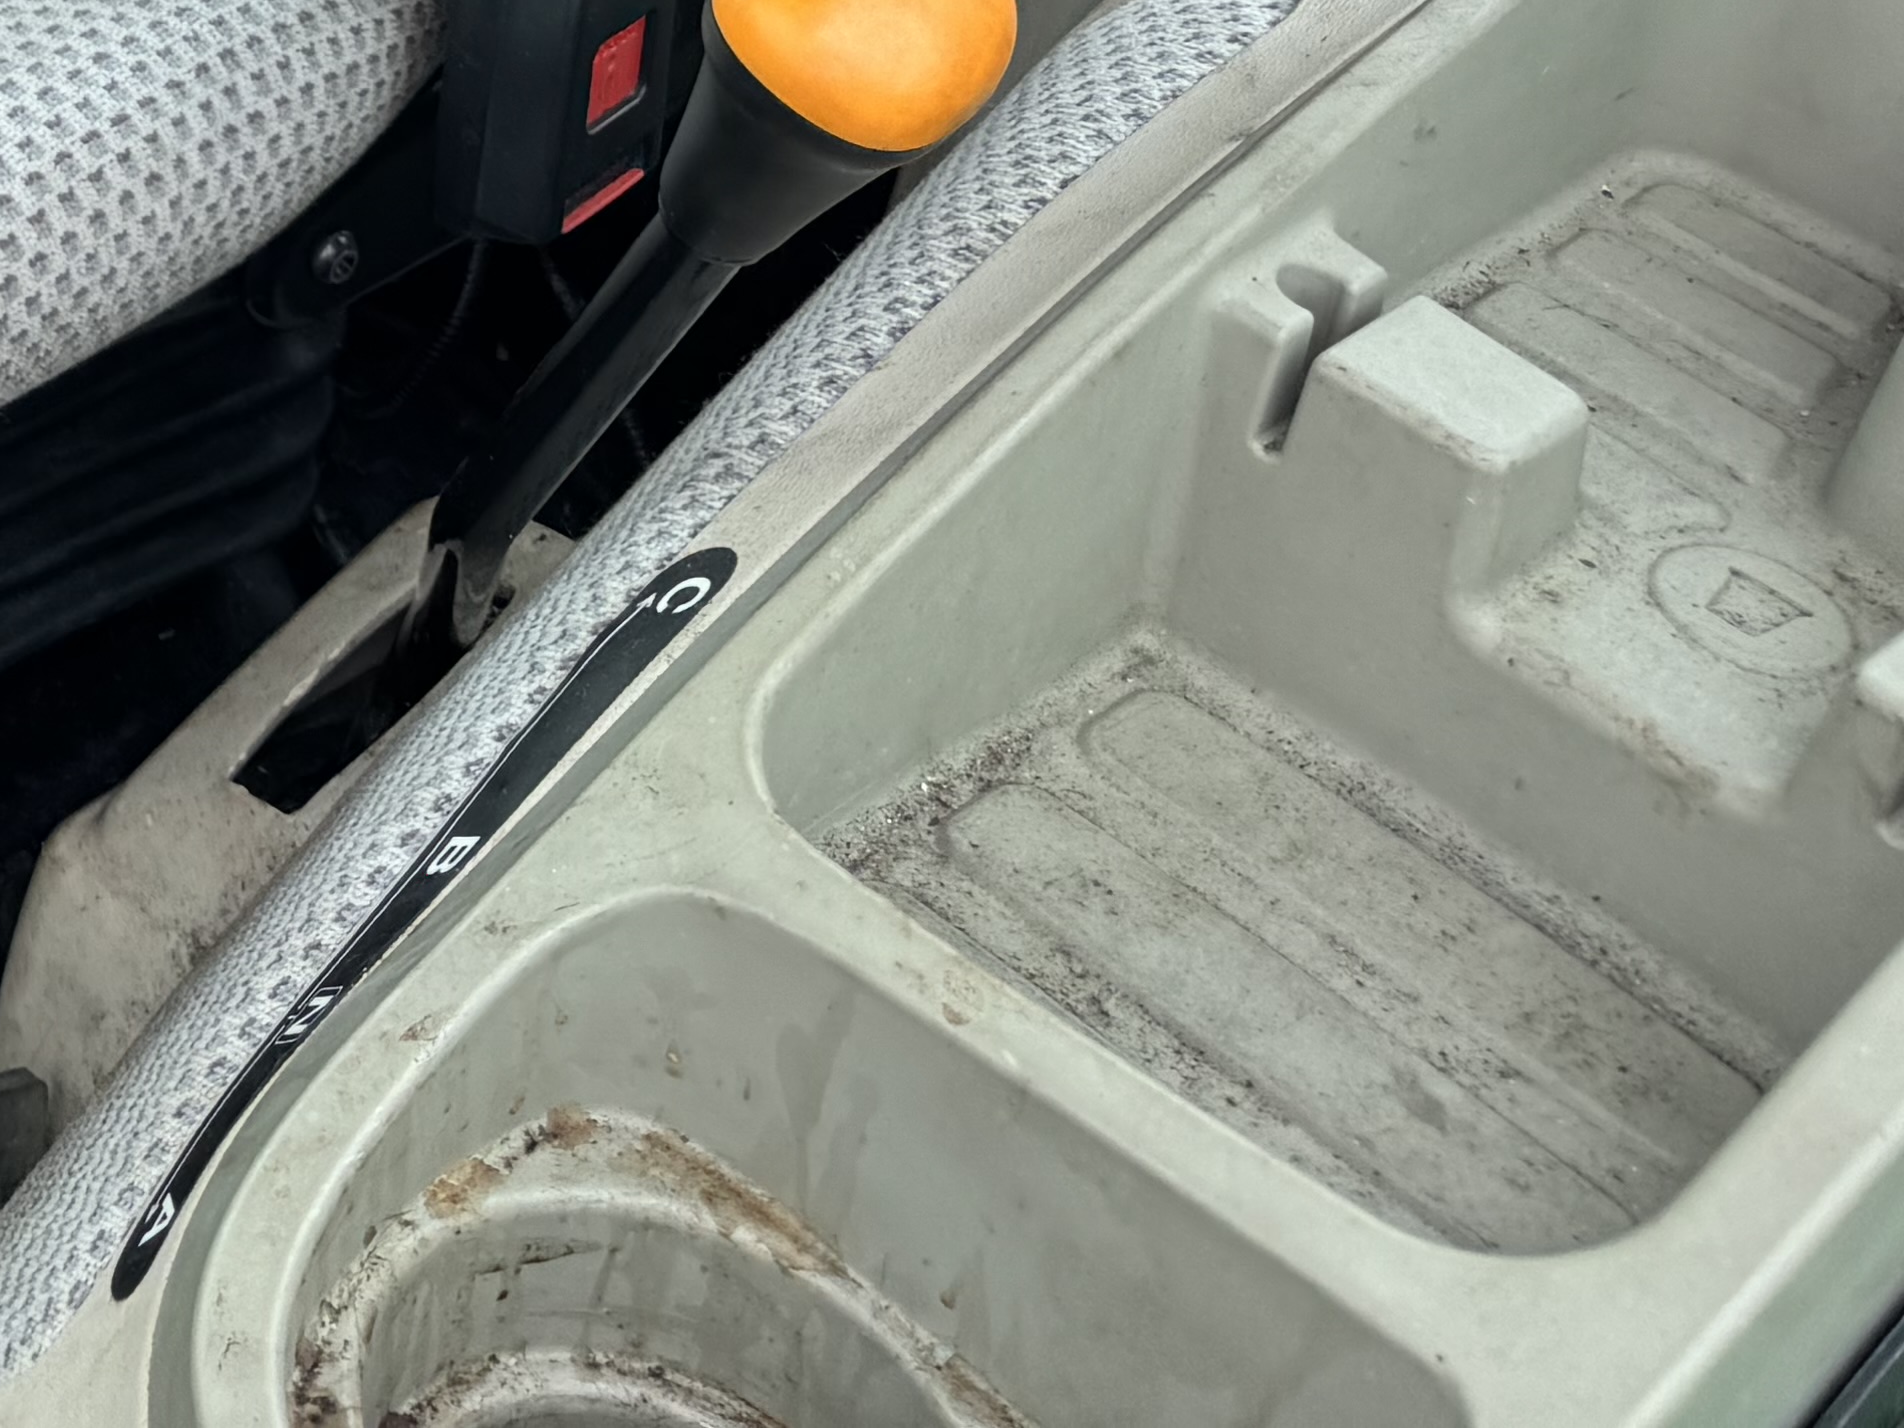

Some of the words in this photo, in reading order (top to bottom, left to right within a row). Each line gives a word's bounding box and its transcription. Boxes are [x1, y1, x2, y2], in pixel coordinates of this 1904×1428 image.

[656, 577, 711, 614] C
[426, 836, 481, 875] B
[283, 995, 335, 1035] N
[137, 1192, 175, 1247] A
